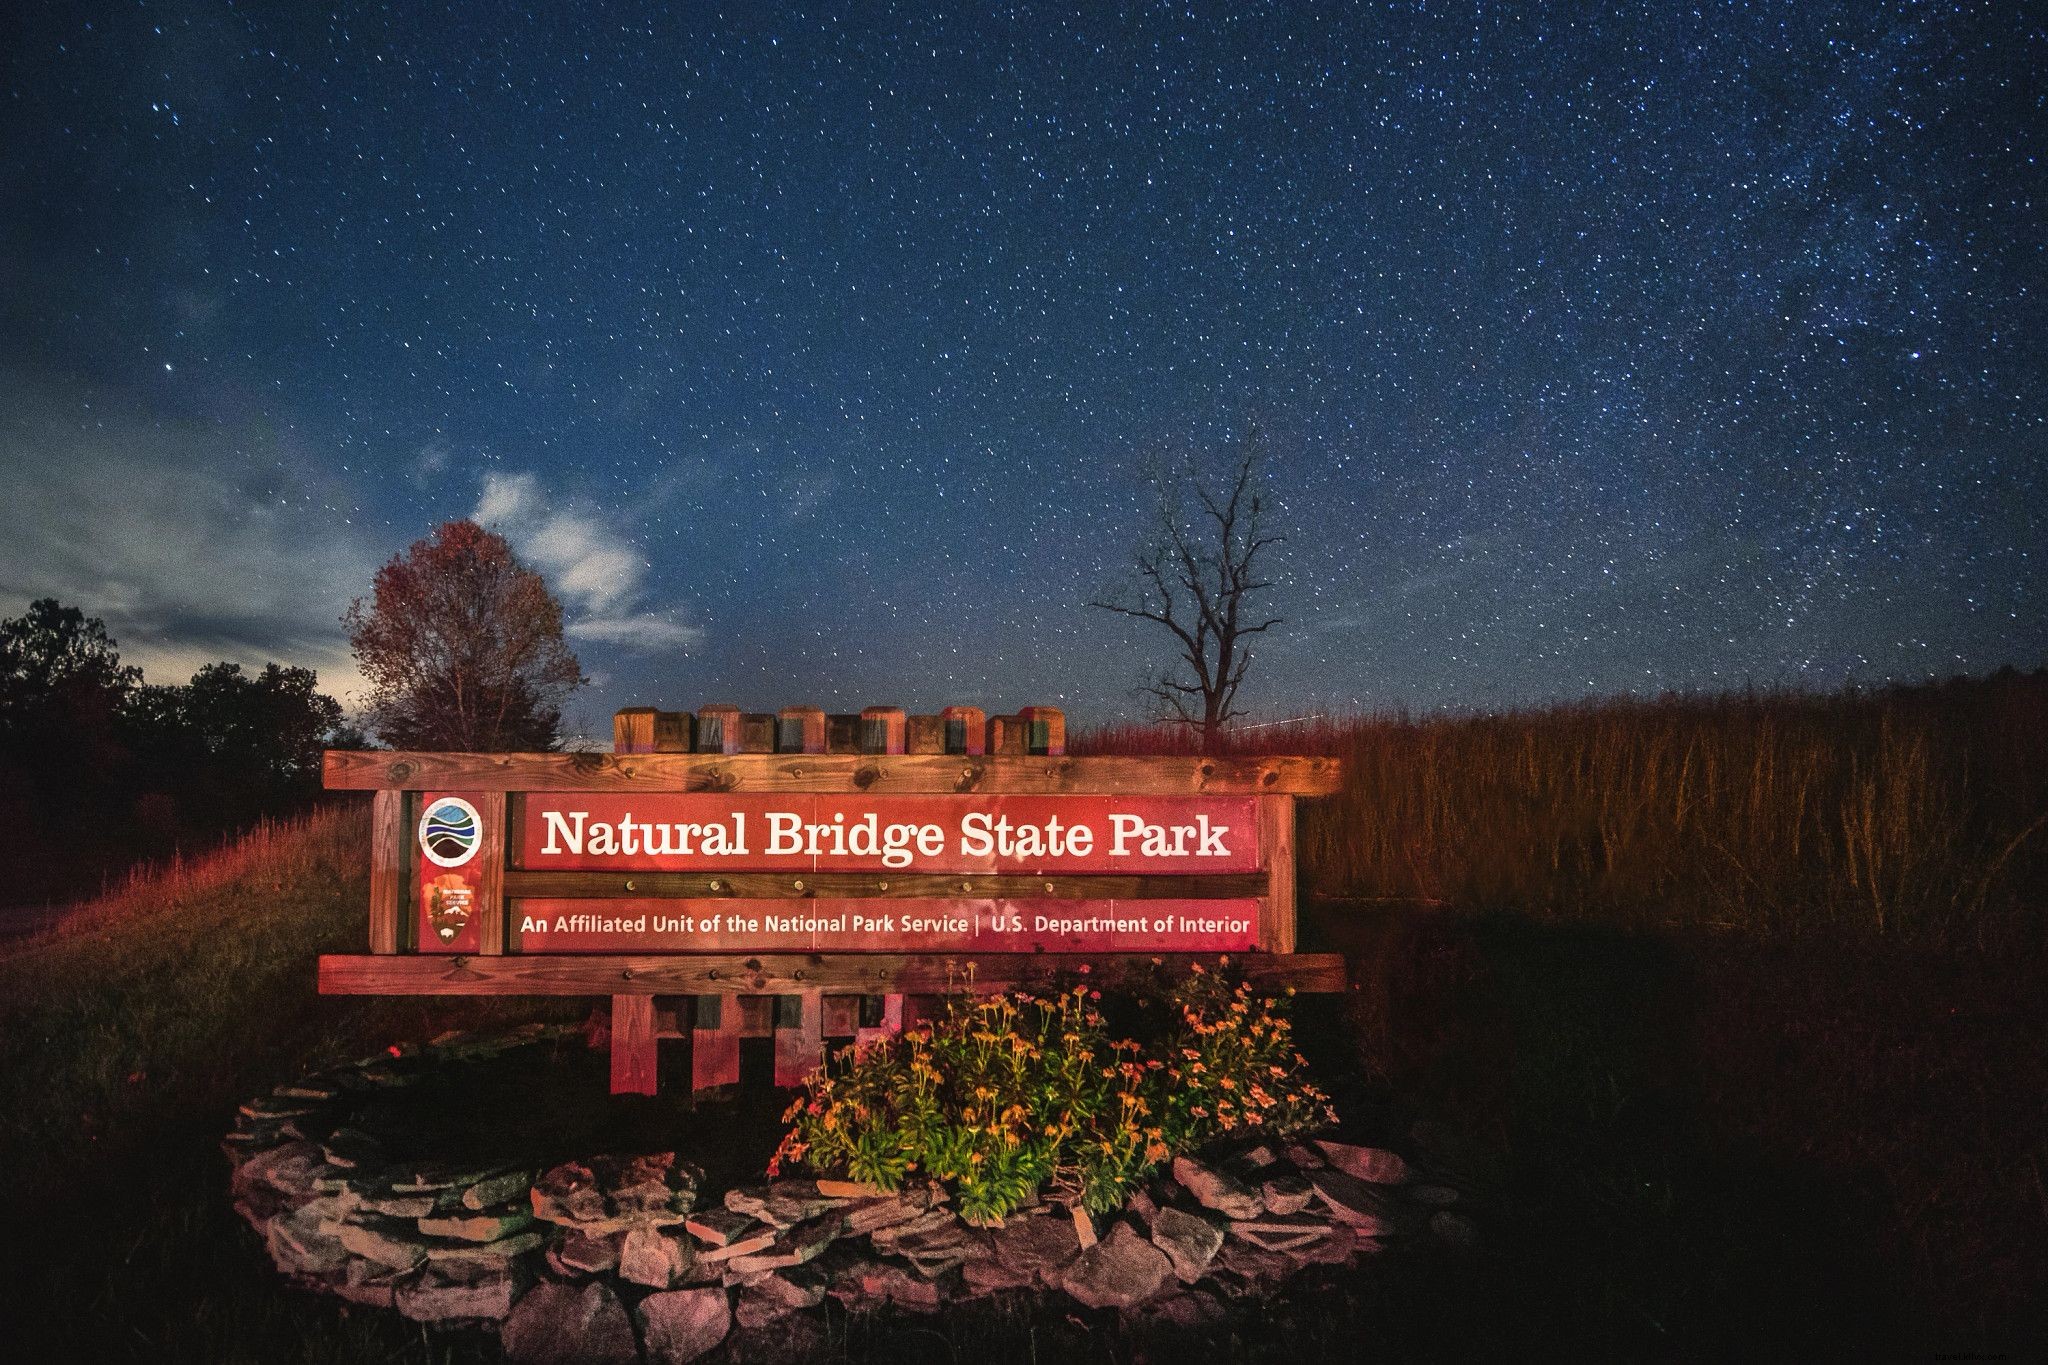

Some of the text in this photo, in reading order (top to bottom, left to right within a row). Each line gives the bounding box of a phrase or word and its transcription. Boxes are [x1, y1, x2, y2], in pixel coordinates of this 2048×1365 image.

[541, 811, 1231, 868] Natural Bridge State Park
[520, 915, 548, 933] An
[554, 914, 646, 933] Affiliated
[653, 915, 694, 933] Unit
[700, 914, 721, 933] of
[727, 914, 759, 933] the
[765, 914, 846, 933] National
[853, 915, 895, 932] Park
[901, 915, 969, 933] Service
[991, 916, 1028, 933] U.S.
[1035, 915, 1148, 938] Department
[1153, 915, 1174, 933] of
[1180, 916, 1250, 933] Interior
